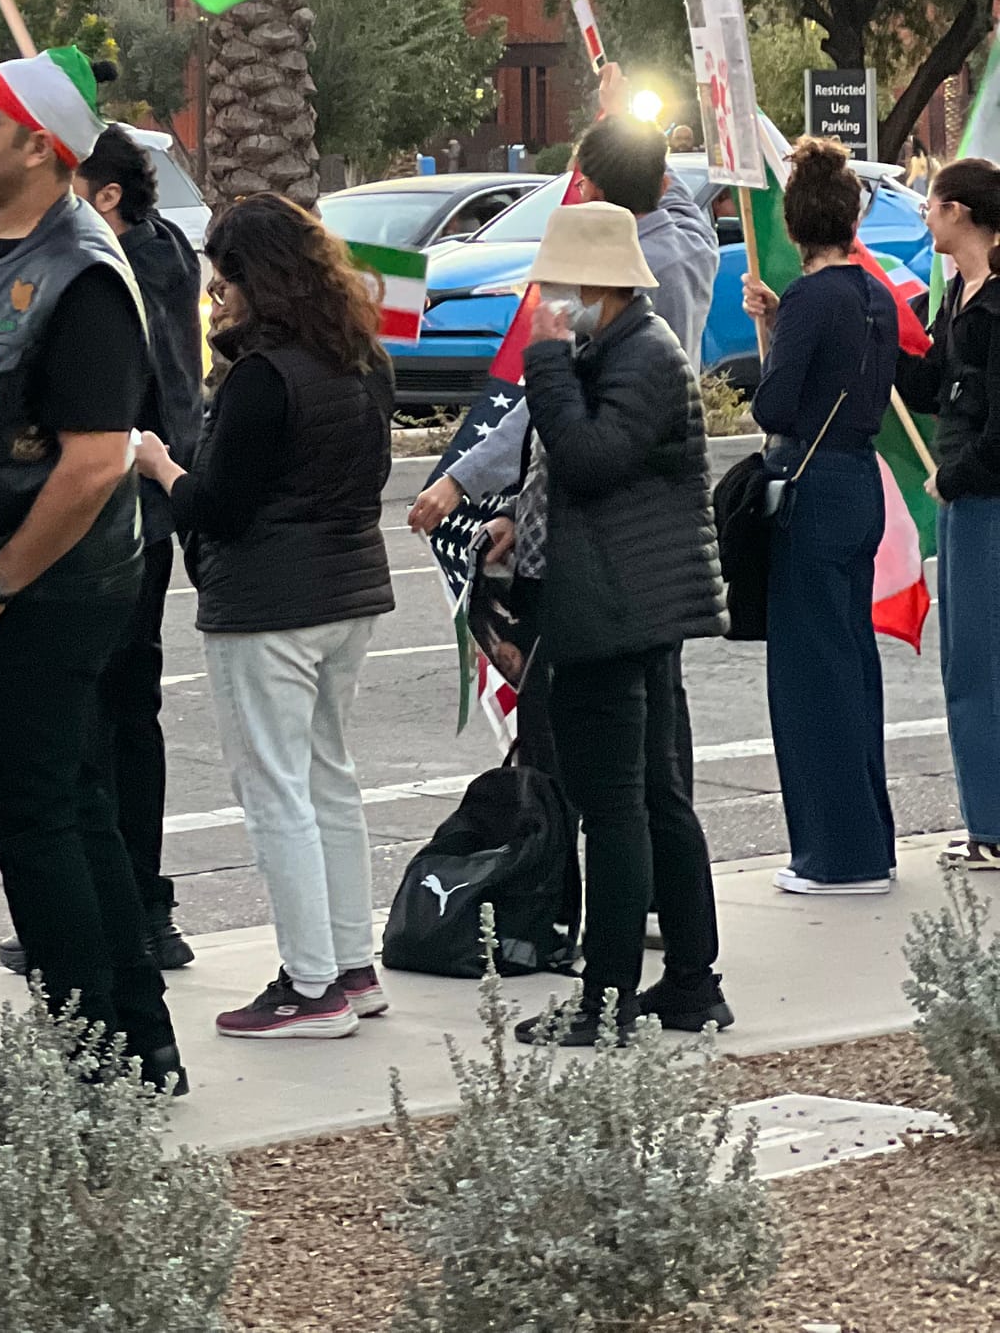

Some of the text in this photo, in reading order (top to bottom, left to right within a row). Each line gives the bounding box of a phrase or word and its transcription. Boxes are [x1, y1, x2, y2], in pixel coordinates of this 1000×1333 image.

[815, 83, 866, 96] Restricted
[831, 102, 850, 114] Use
[821, 119, 860, 135] Parking
